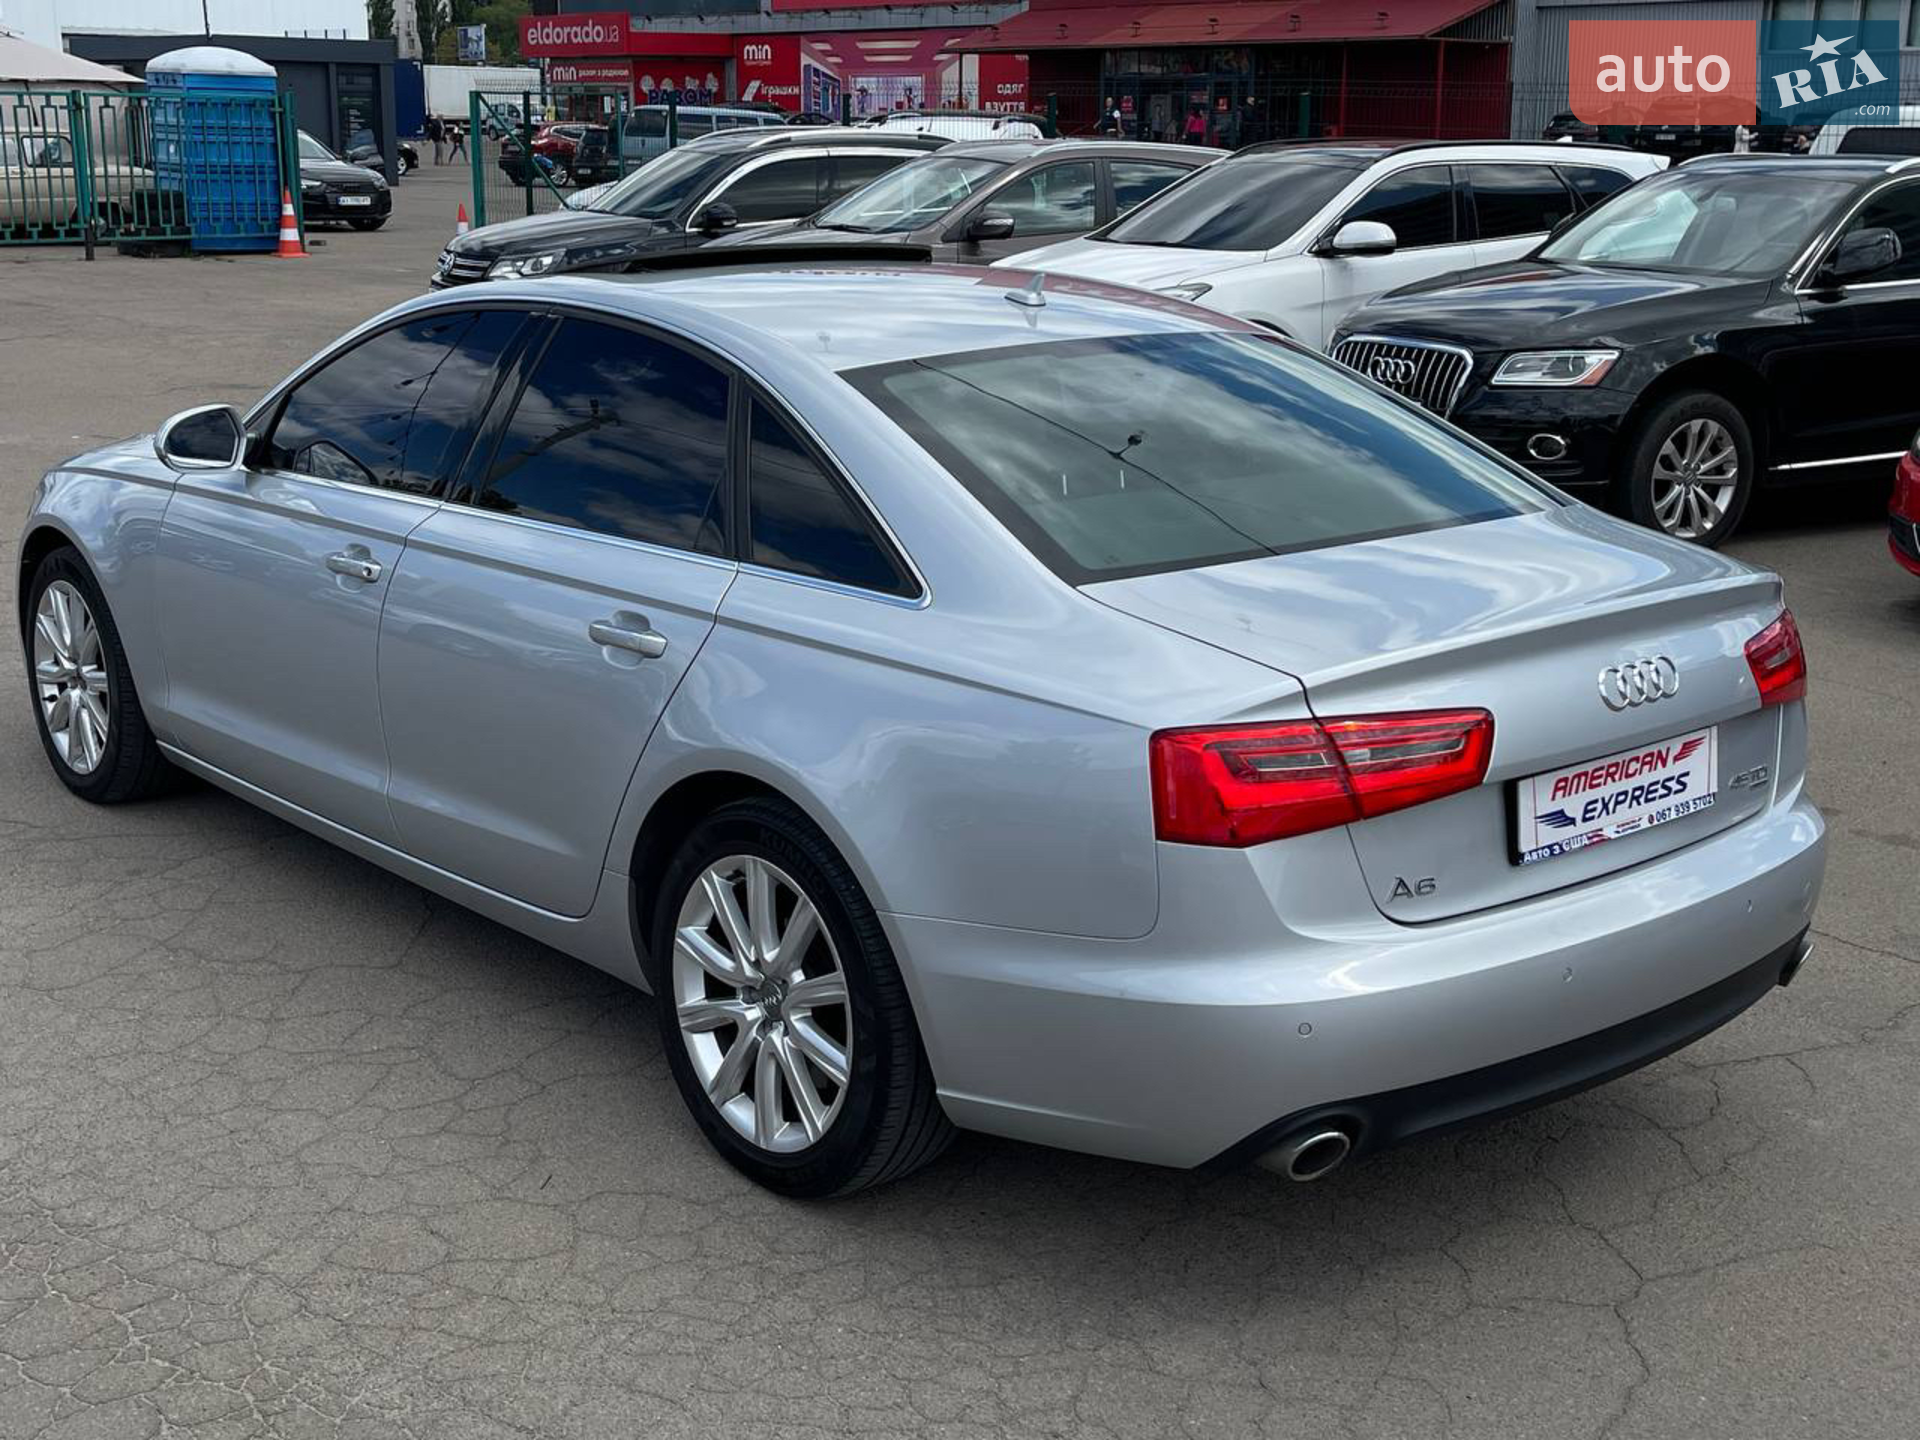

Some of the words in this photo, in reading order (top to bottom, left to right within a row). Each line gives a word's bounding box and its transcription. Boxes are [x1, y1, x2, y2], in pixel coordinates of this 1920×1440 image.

[1551, 747, 1671, 801] AMERICAN
[1581, 770, 1691, 823] EXPRESS
[1655, 808, 1672, 823] 067
[1674, 801, 1691, 816] 939
[1562, 834, 1590, 852] США
[1386, 876, 1436, 904] A6
